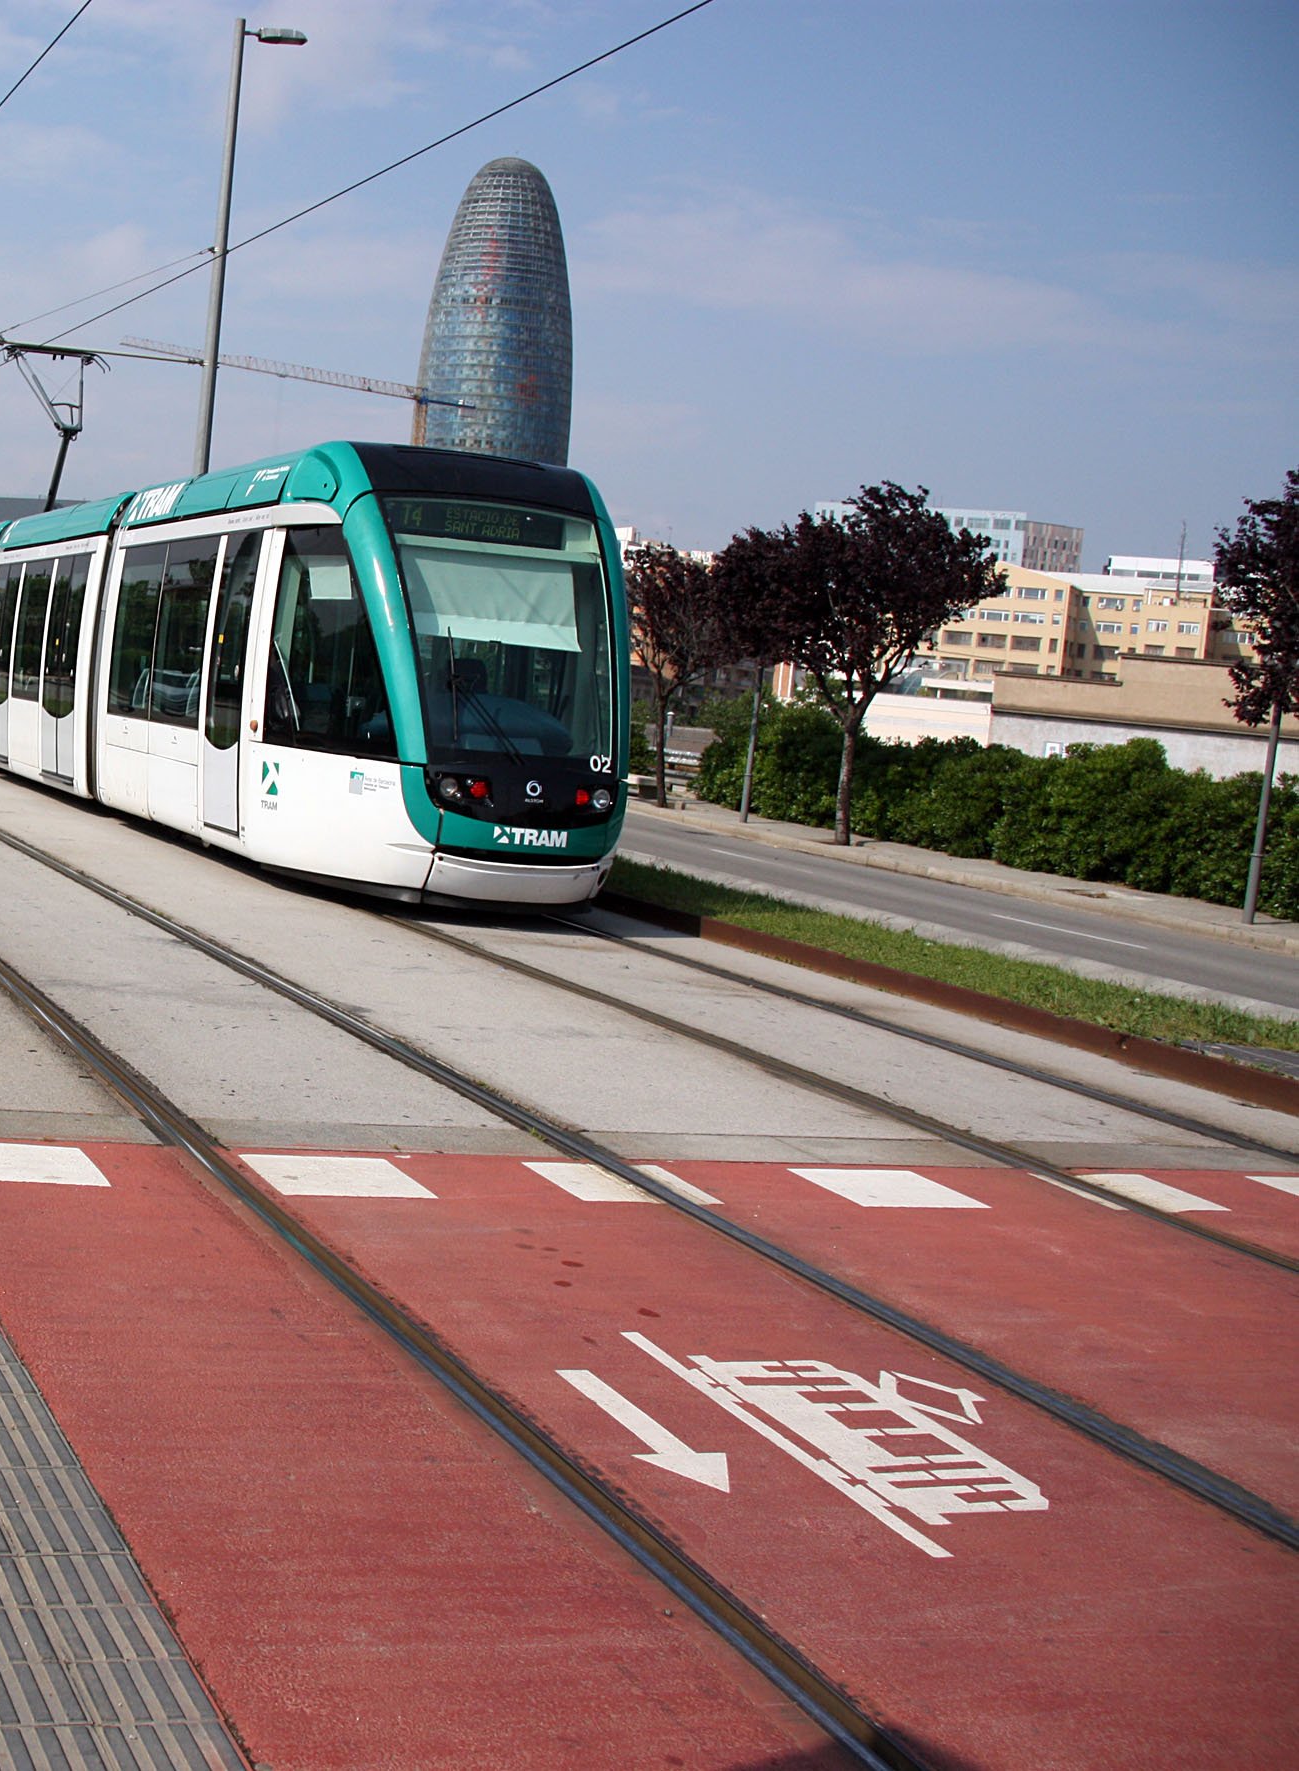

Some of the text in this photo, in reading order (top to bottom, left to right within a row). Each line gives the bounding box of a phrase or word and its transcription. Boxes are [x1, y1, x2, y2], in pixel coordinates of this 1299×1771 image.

[136, 482, 186, 520] TRAM
[402, 503, 423, 527] T4
[503, 511, 518, 526] DE
[445, 520, 477, 534] SANT
[590, 755, 611, 773] 02
[261, 800, 278, 811] TRAM
[511, 827, 568, 848] TRAM
